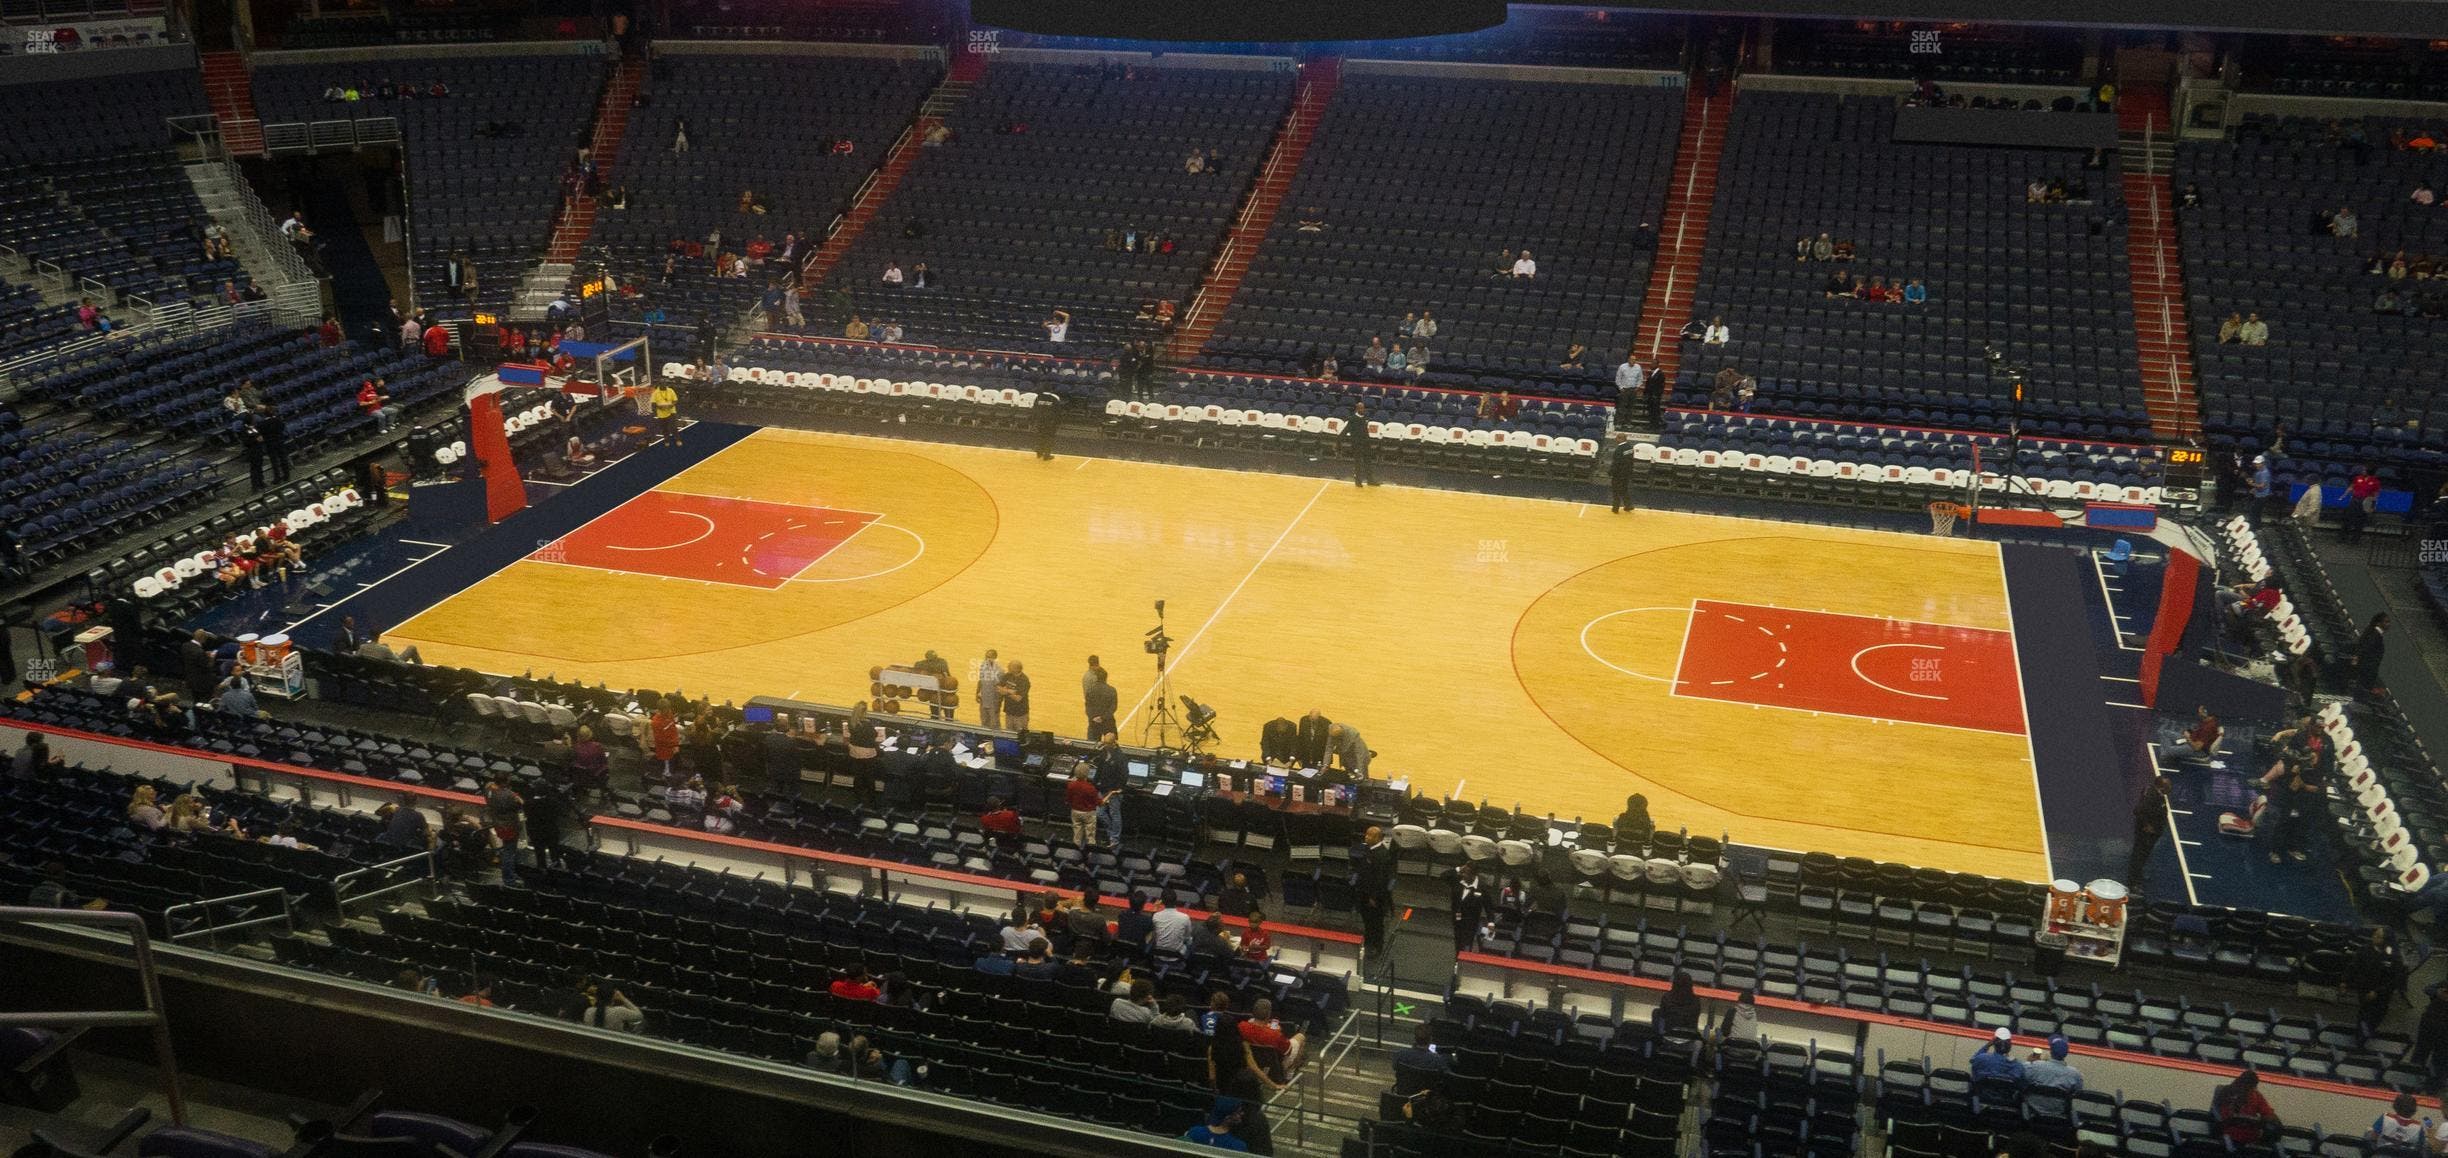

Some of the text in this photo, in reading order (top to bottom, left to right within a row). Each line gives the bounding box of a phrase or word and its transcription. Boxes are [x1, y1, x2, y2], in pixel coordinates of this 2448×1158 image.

[1273, 62, 1290, 72] 112
[1661, 76, 1678, 86] 111
[2171, 450, 2201, 462] 22:11
[2059, 898, 2068, 907] G
[2100, 905, 2110, 914] G
